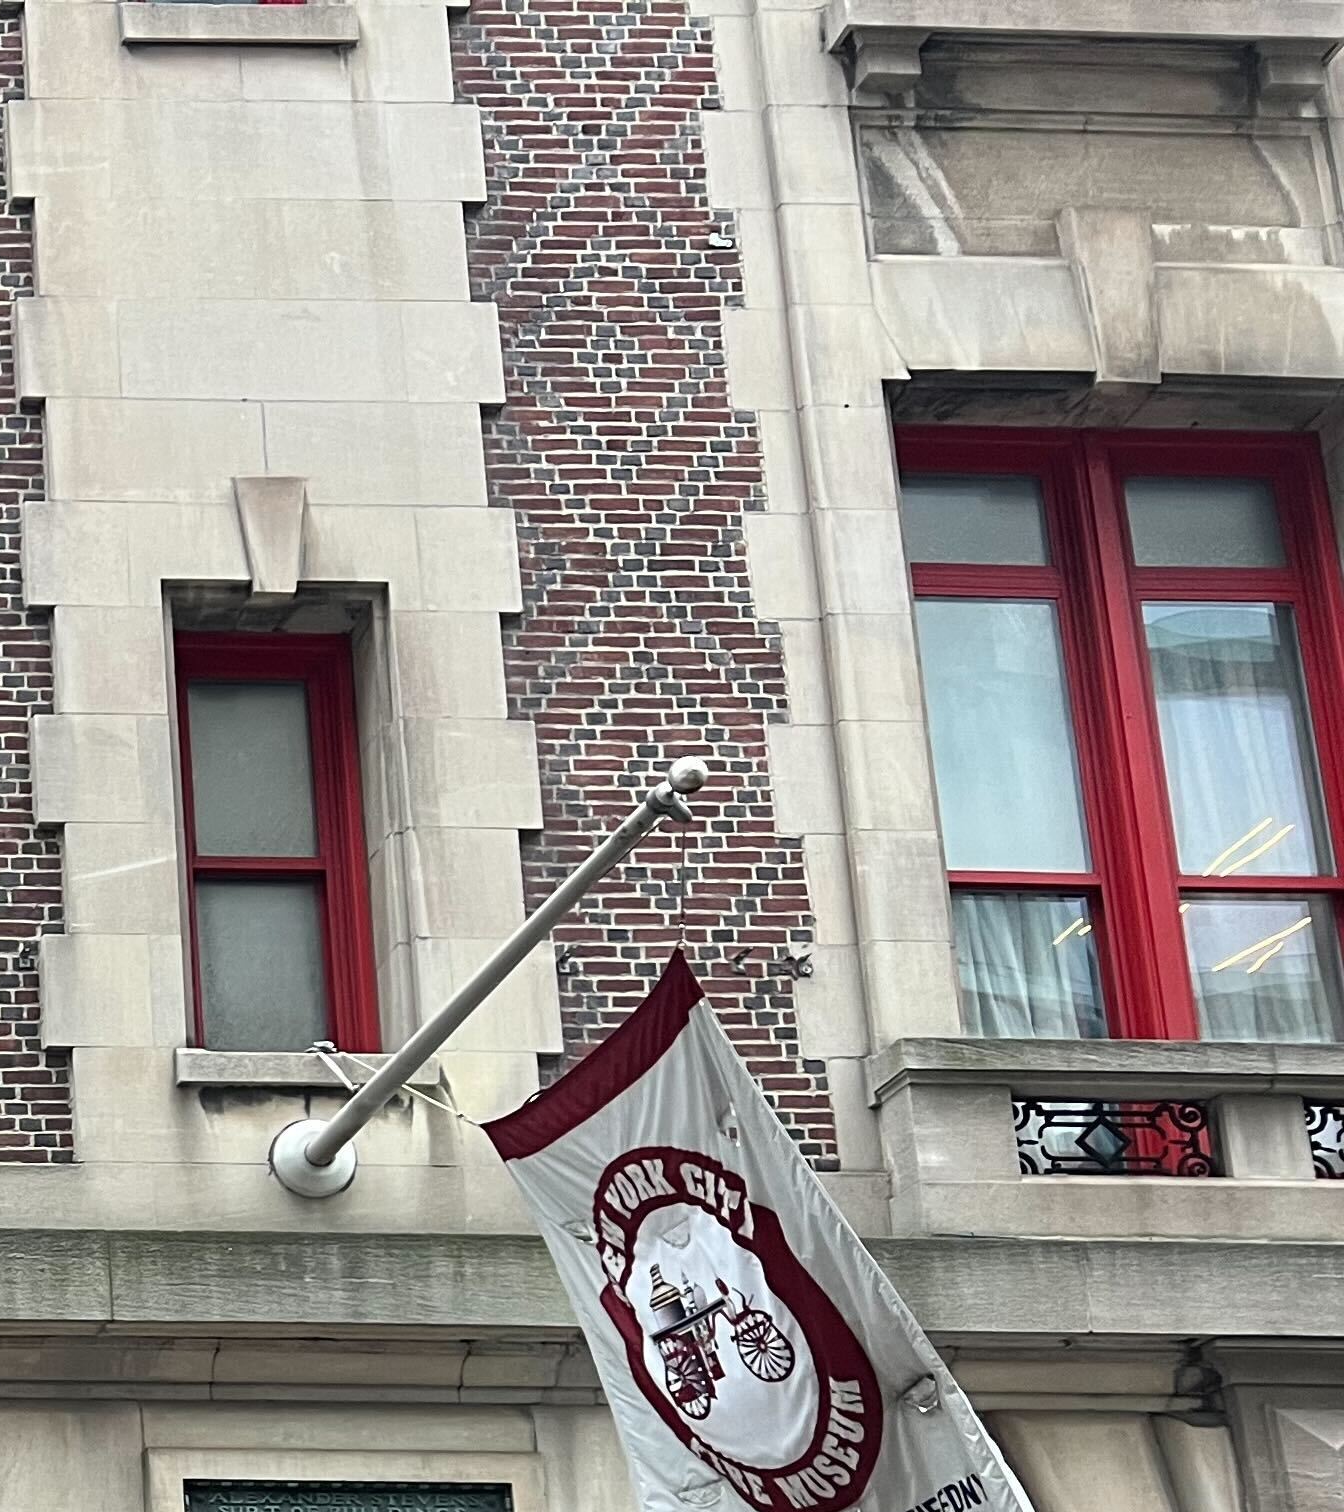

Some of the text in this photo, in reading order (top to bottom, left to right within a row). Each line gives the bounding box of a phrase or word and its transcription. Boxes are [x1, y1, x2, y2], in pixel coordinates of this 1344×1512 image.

[604, 1158, 677, 1220] YORK
[773, 1375, 866, 1509] MUSEUM
[208, 1493, 363, 1505] ALEXANDER
